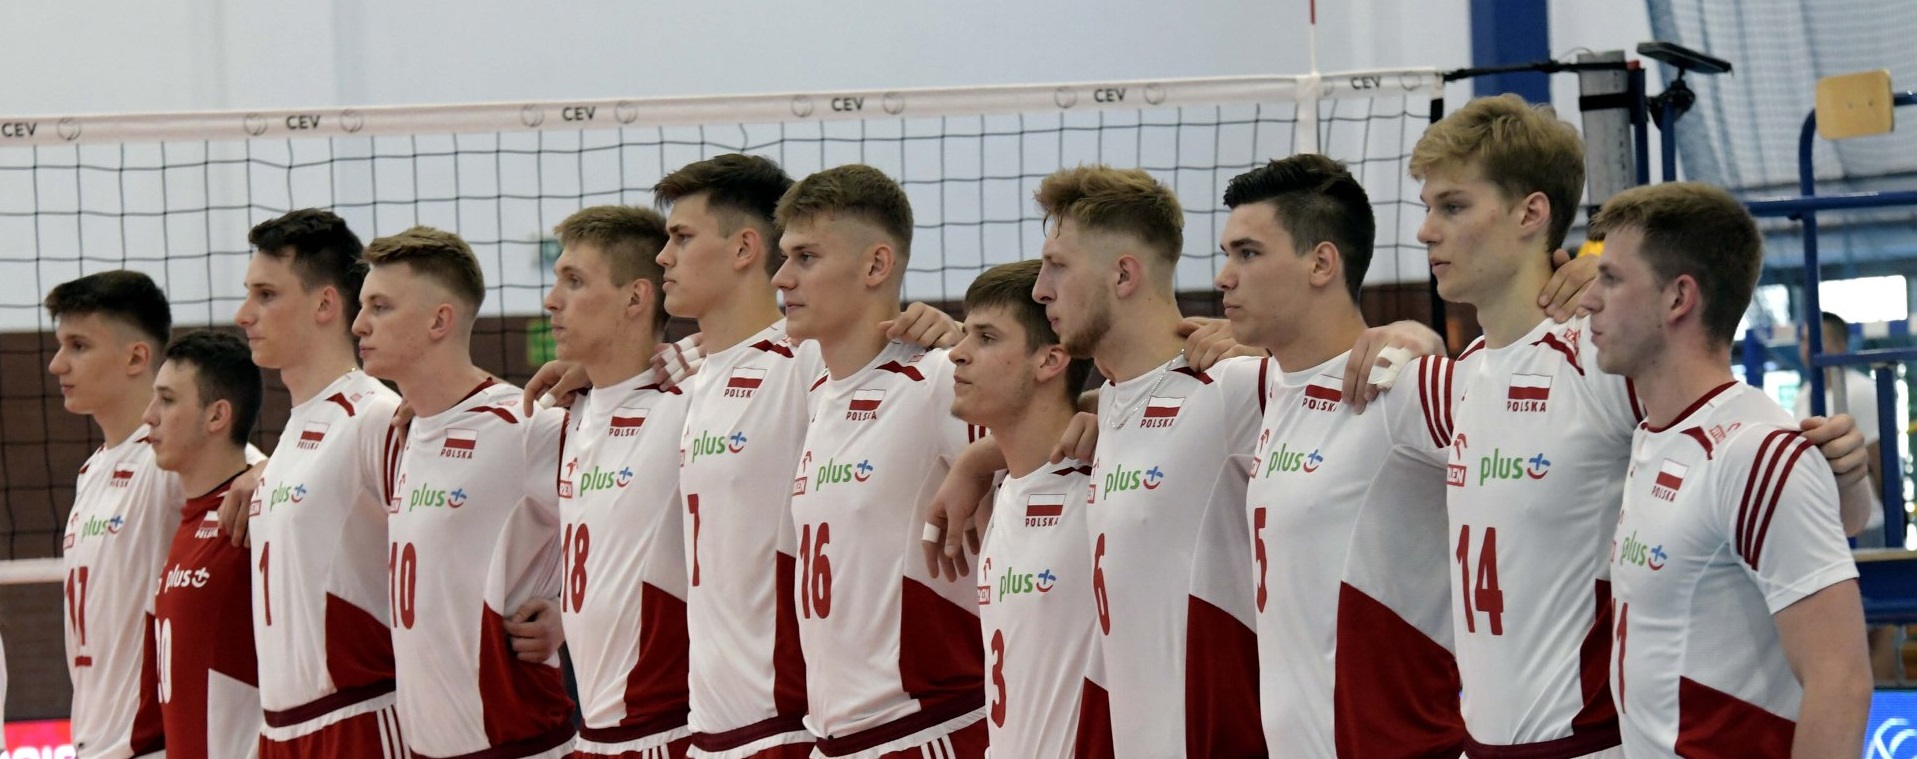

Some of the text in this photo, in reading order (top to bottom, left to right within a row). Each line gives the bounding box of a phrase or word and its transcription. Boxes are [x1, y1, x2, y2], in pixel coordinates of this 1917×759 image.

[1094, 87, 1126, 103] CEV
[1350, 76, 1381, 90] CEV
[562, 106, 596, 121] CEV
[831, 96, 864, 112] CEV
[1, 122, 37, 137] CEV
[286, 115, 321, 130] CEV
[1507, 400, 1546, 412] POLSKA
[1140, 418, 1175, 428] POLSKA
[440, 448, 473, 460] POLSKA
[692, 430, 726, 463] plus
[1266, 443, 1304, 479] plus
[580, 466, 615, 498] plus
[816, 457, 852, 491] plus
[1104, 464, 1141, 500] plus
[1480, 448, 1523, 487] plus
[270, 481, 292, 512] plus
[409, 483, 445, 512] plus
[1651, 485, 1677, 502] POLSKA
[80, 515, 108, 544] plus
[687, 493, 700, 587] 7
[1254, 507, 1267, 614] 5
[1620, 530, 1648, 566] plus
[164, 563, 193, 594] plus
[259, 541, 272, 626] 1
[562, 523, 590, 614] 18
[800, 522, 832, 619] 16
[999, 566, 1034, 602] plus
[1093, 532, 1111, 636] 6
[1456, 524, 1504, 636] 14
[389, 542, 417, 630] 10
[991, 629, 1007, 728] 3
